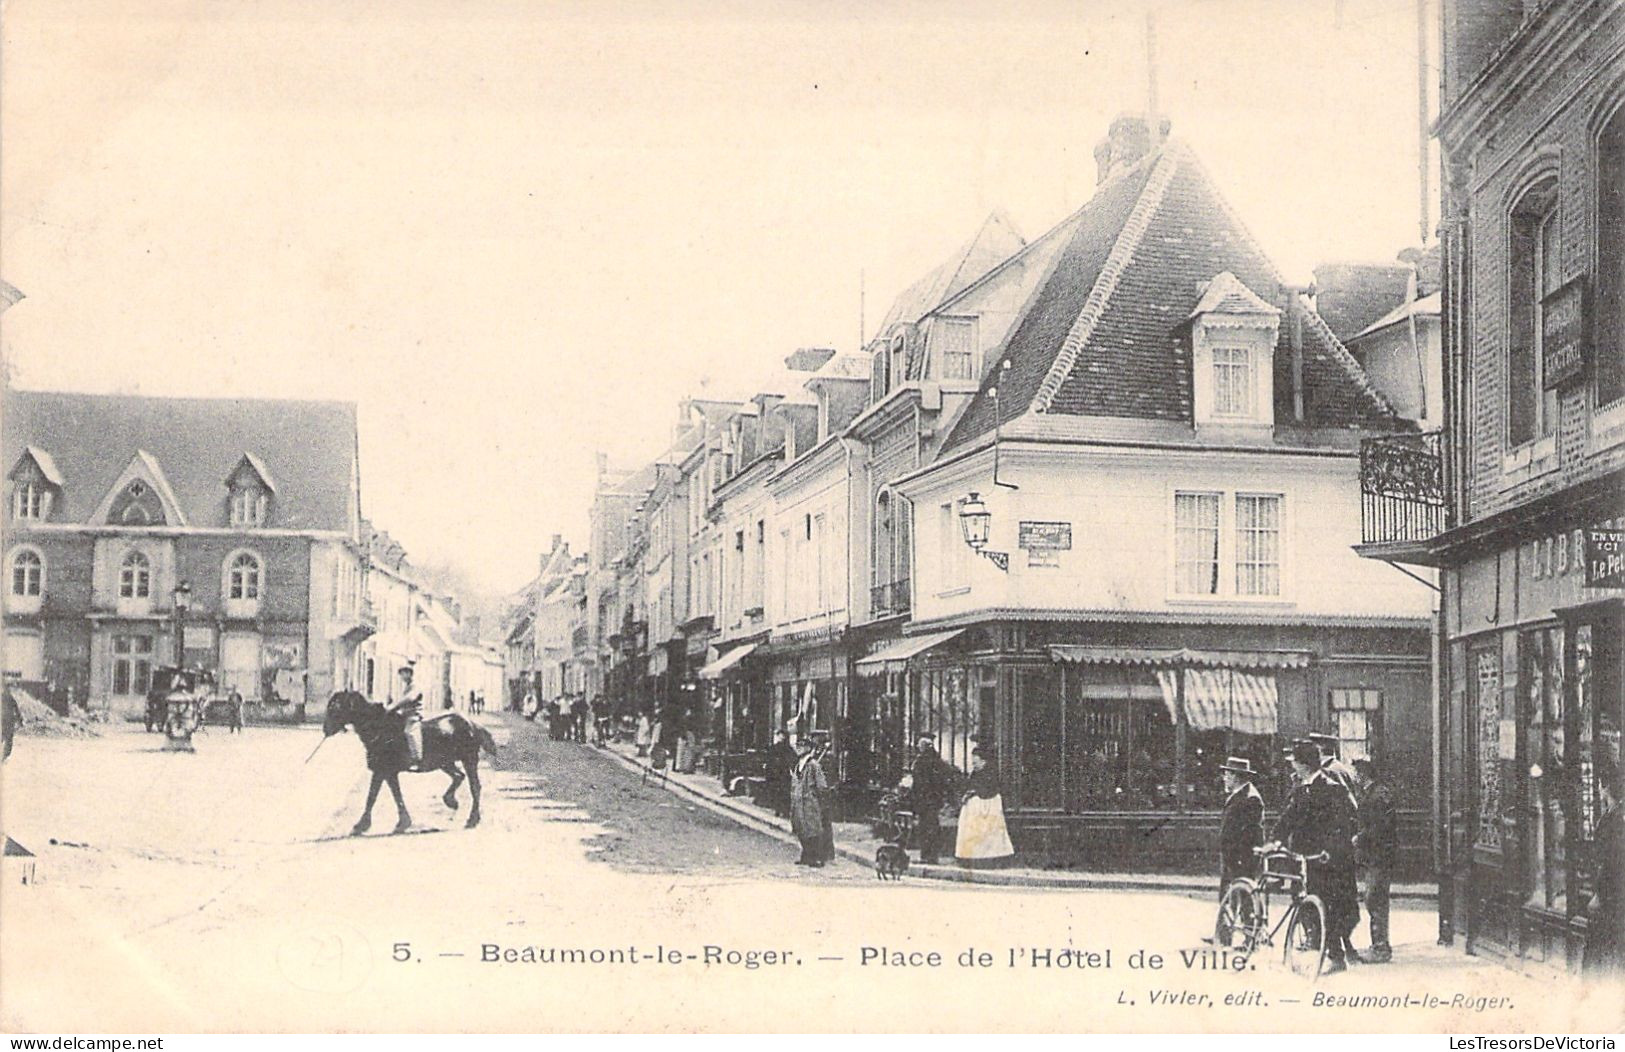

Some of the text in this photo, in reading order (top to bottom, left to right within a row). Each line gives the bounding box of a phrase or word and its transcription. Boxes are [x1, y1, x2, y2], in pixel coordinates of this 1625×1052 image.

[1591, 532, 1625, 542] EN VE
[1597, 542, 1618, 551] ICI
[1592, 560, 1606, 581] Le
